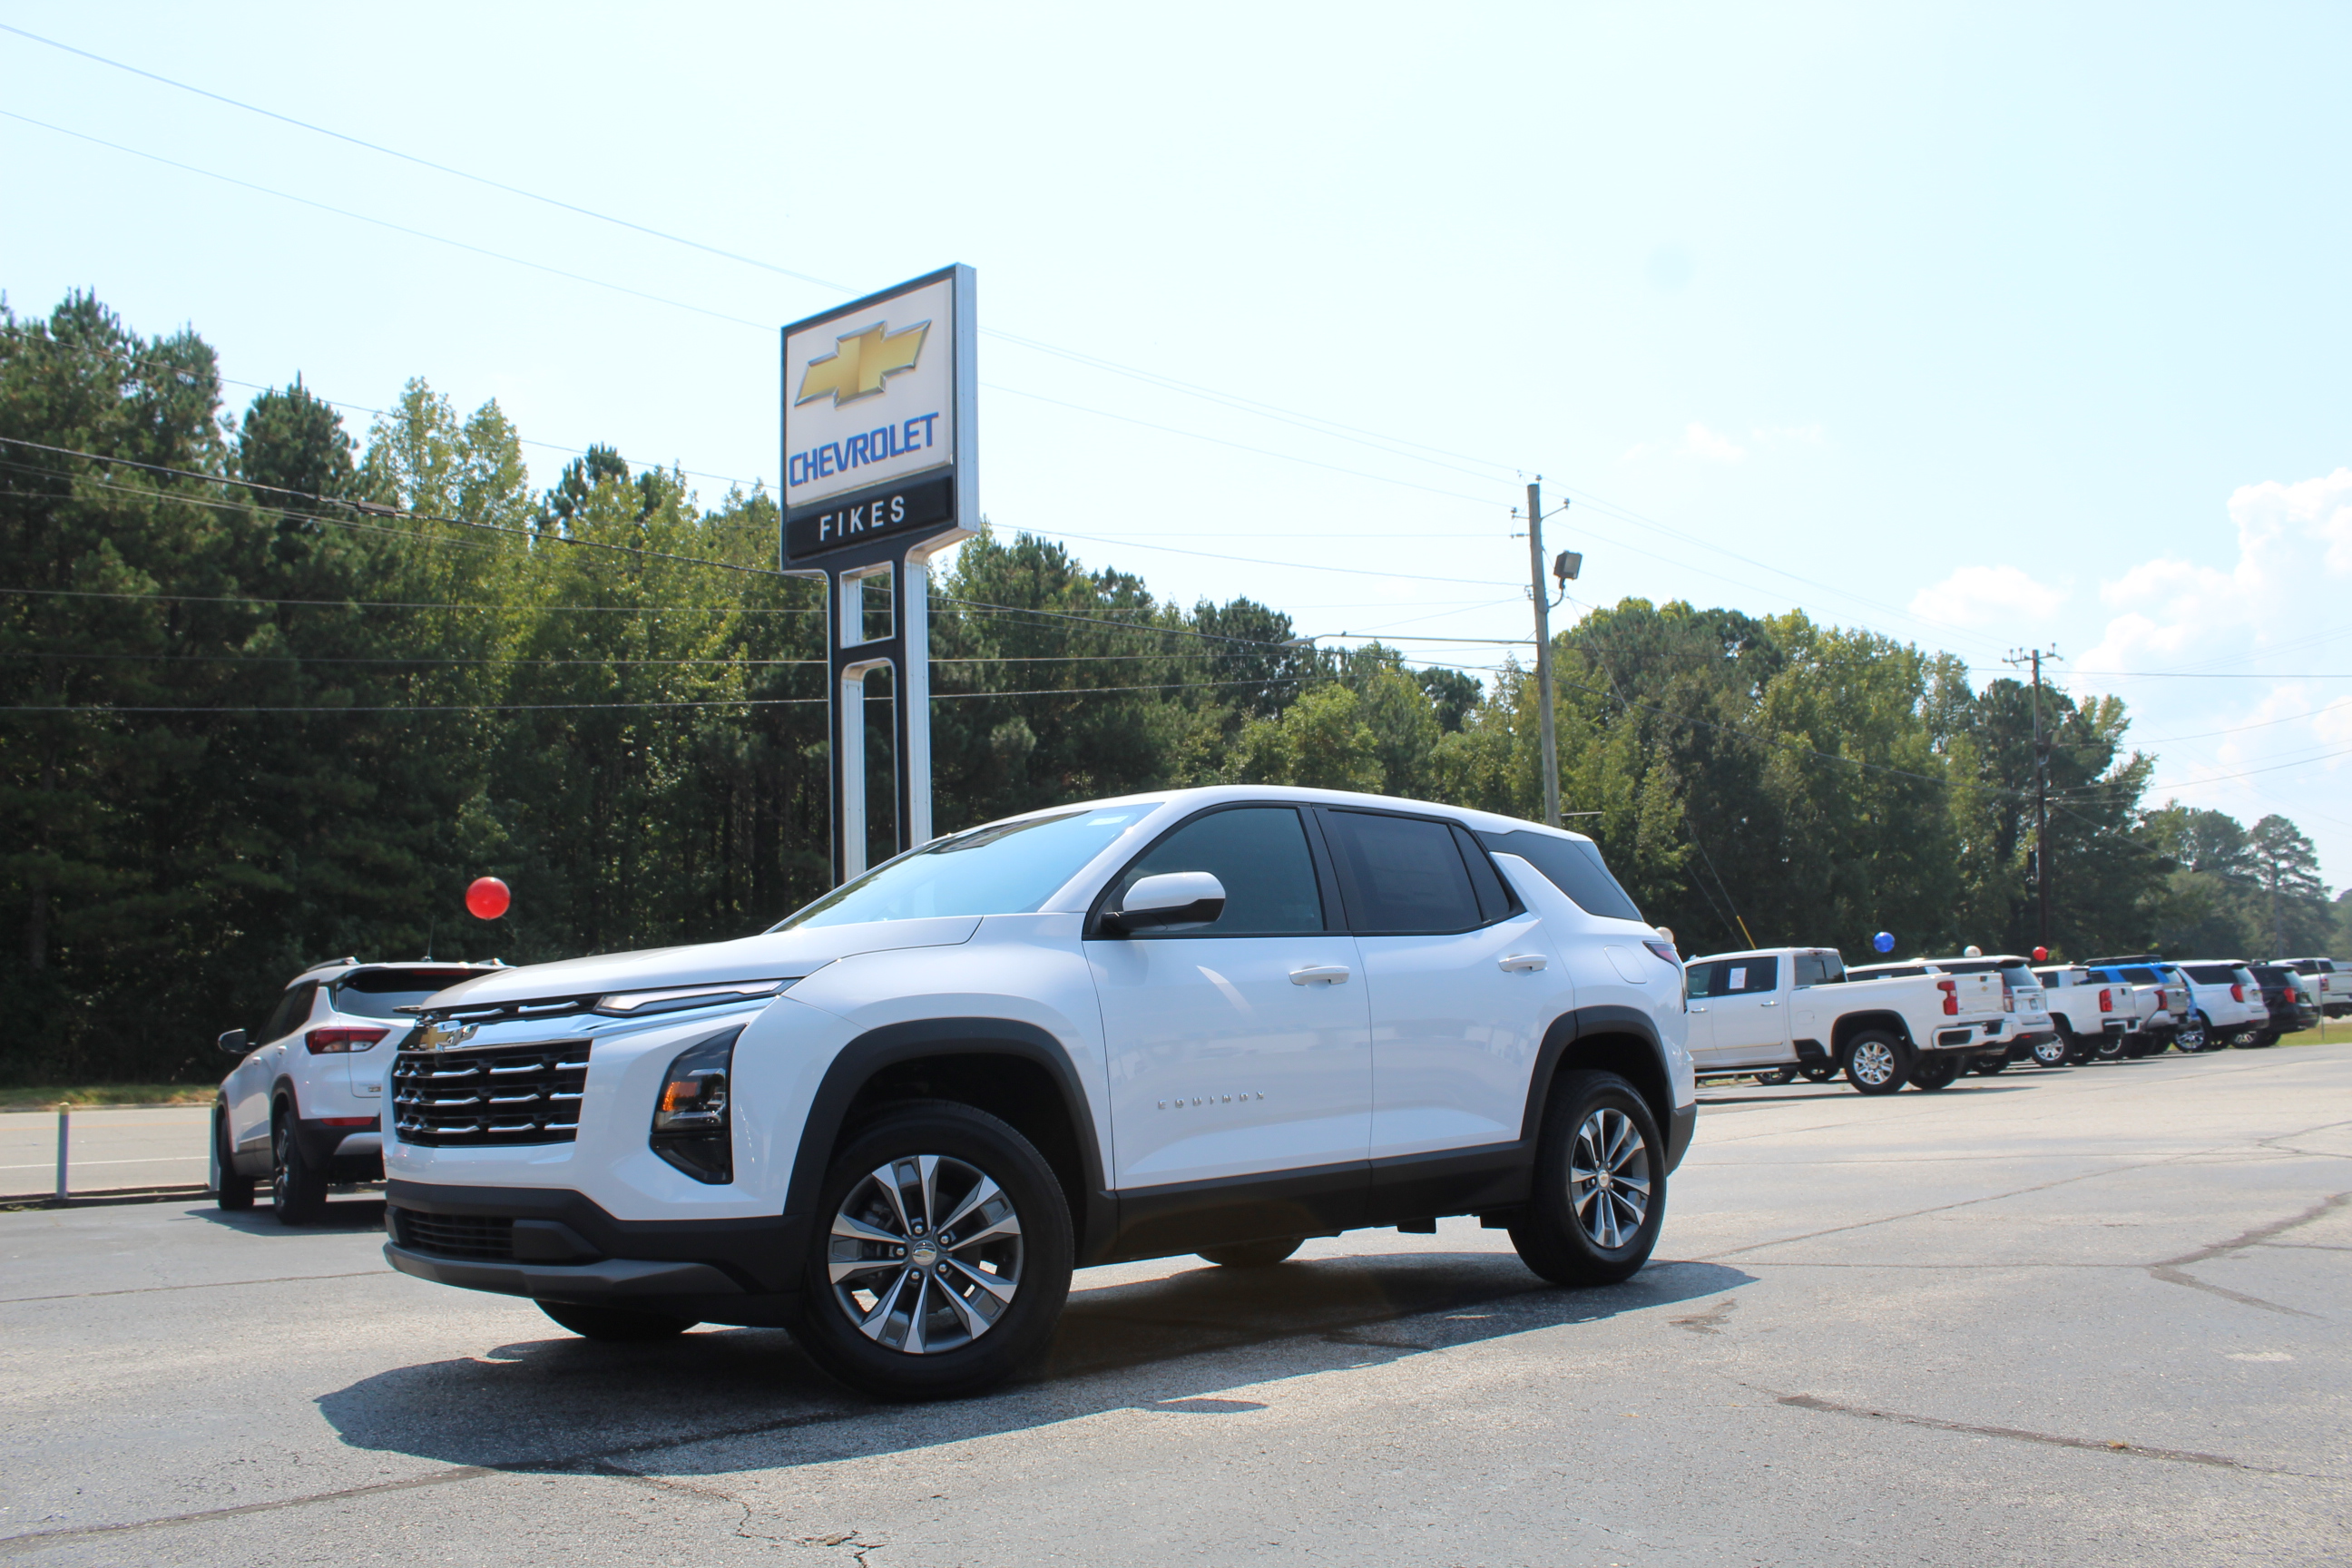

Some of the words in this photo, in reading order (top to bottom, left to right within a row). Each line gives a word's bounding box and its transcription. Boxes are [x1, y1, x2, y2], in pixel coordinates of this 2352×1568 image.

[789, 412, 938, 487] CHEVROLET
[819, 495, 905, 542] FIKES
[1158, 1091, 1265, 1110] EQUINOX
